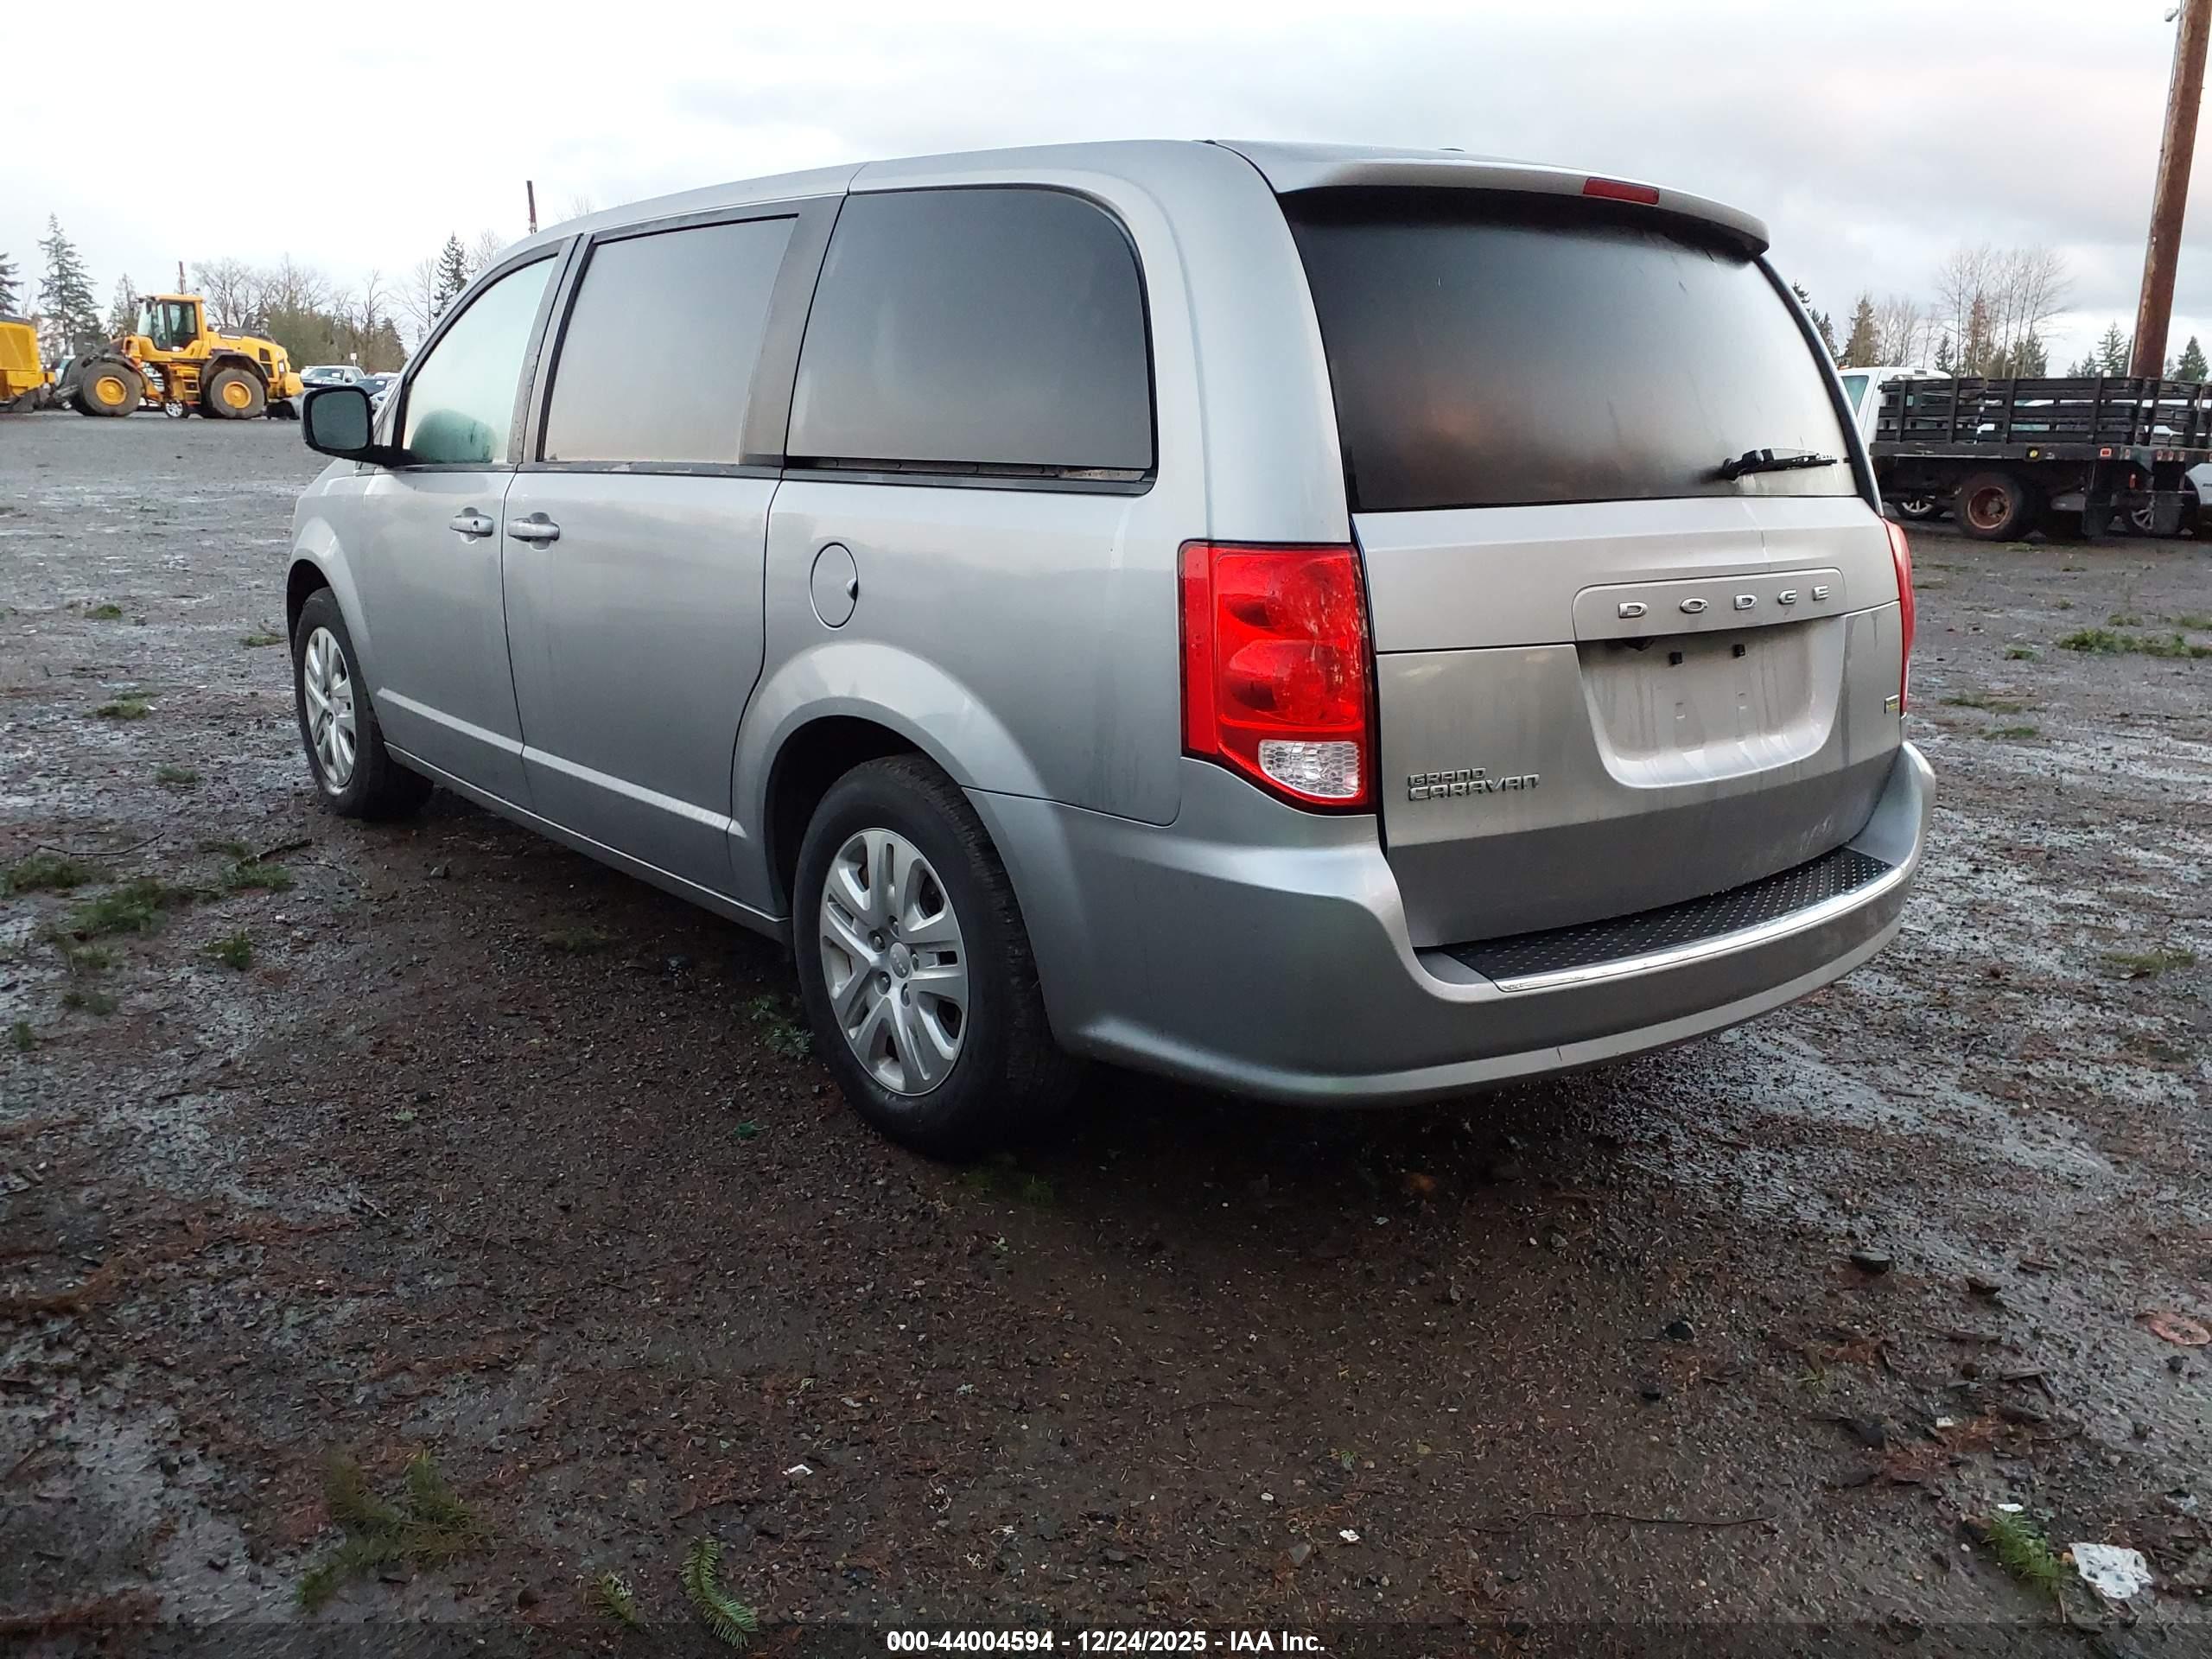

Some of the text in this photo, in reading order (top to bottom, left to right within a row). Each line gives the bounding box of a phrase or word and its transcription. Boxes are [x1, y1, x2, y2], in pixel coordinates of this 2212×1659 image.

[1618, 585, 1829, 619] DODGE
[1408, 767, 1486, 787] GRAND
[1408, 773, 1541, 801] CARAVAN
